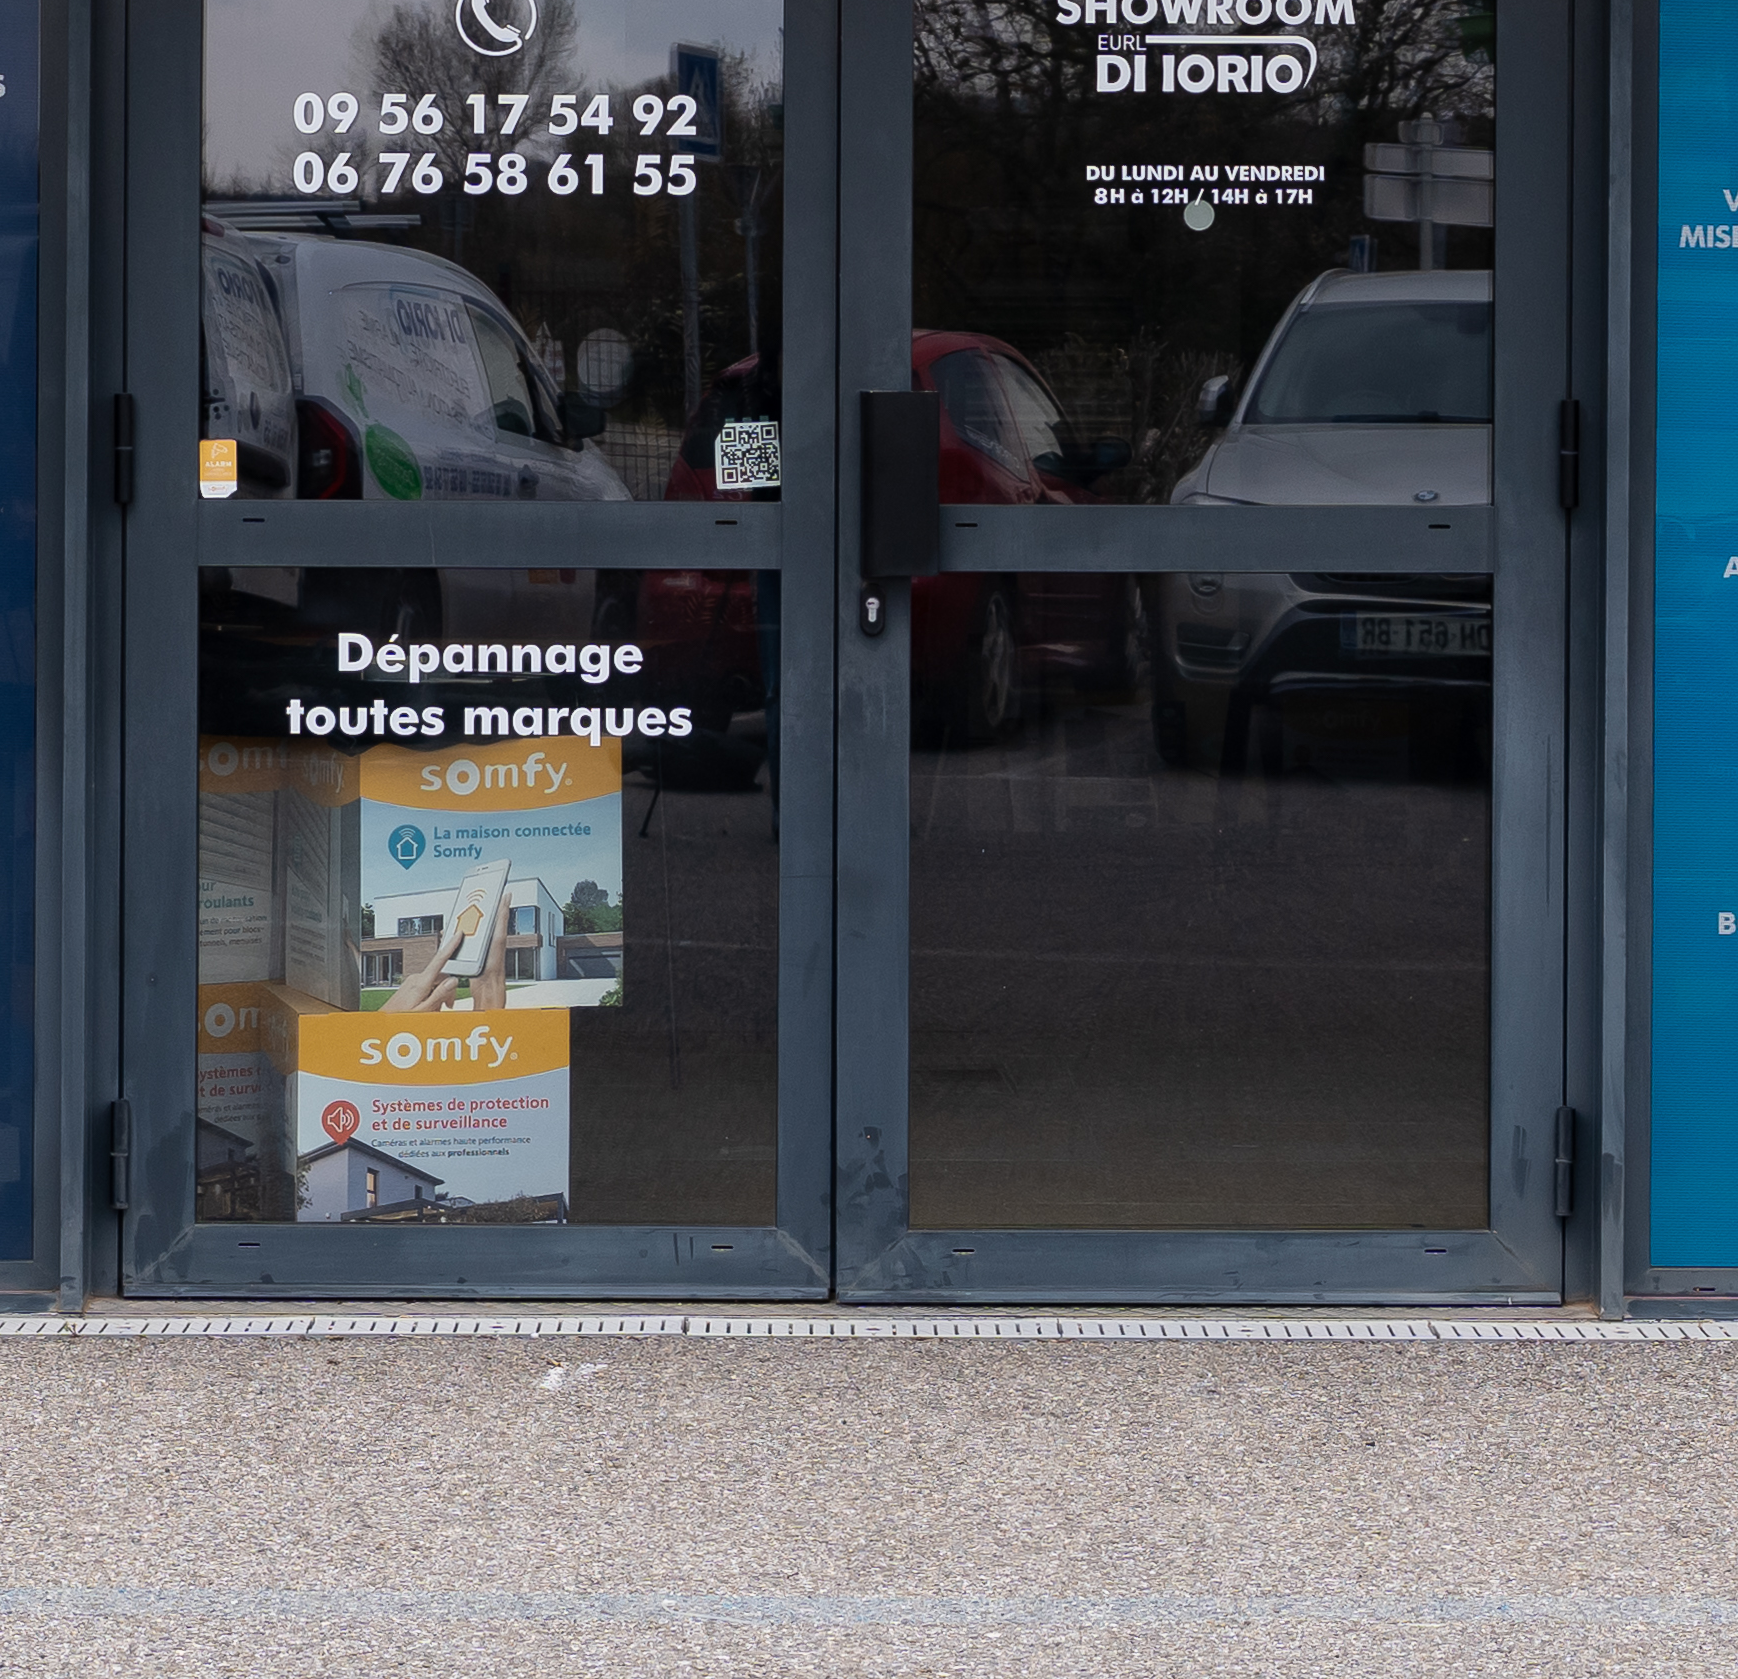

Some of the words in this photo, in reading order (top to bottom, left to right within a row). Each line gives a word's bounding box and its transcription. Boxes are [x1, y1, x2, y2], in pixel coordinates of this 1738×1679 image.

[1098, 35, 1146, 51] EURL
[1097, 55, 1146, 92] DI
[1162, 54, 1302, 93] IORIO
[293, 93, 359, 135] 09
[379, 93, 443, 135] 56
[466, 94, 529, 135] 17
[548, 95, 613, 135] 54
[633, 95, 697, 135] 92
[293, 153, 359, 194] 06
[379, 153, 443, 194] 76
[463, 153, 527, 195] 58
[547, 154, 605, 195] 61
[633, 155, 697, 195] 55
[1086, 165, 1116, 181] DU
[1122, 165, 1184, 181] LUNDI
[1190, 166, 1219, 181] AU
[1225, 166, 1324, 181] VENDREDI
[1095, 188, 1124, 204] 8H
[1131, 187, 1143, 204] à
[1151, 189, 1188, 204] 12H
[1211, 189, 1249, 204] 14H
[1256, 188, 1267, 204] à
[1275, 189, 1313, 204] 17H
[338, 633, 643, 683] Dépannage
[287, 699, 445, 736] toutes
[464, 705, 692, 746] marques
[421, 752, 568, 795] somfy
[433, 826, 450, 840] La
[455, 824, 510, 840] maison
[515, 822, 591, 838] connectée
[433, 842, 483, 861] Somfy
[361, 1026, 513, 1069] somfy
[372, 1099, 442, 1115] Systèmes
[447, 1097, 465, 1110] de
[470, 1096, 549, 1113] protection
[372, 1119, 387, 1130] et
[393, 1117, 410, 1129] de
[416, 1116, 507, 1129] surveillance
